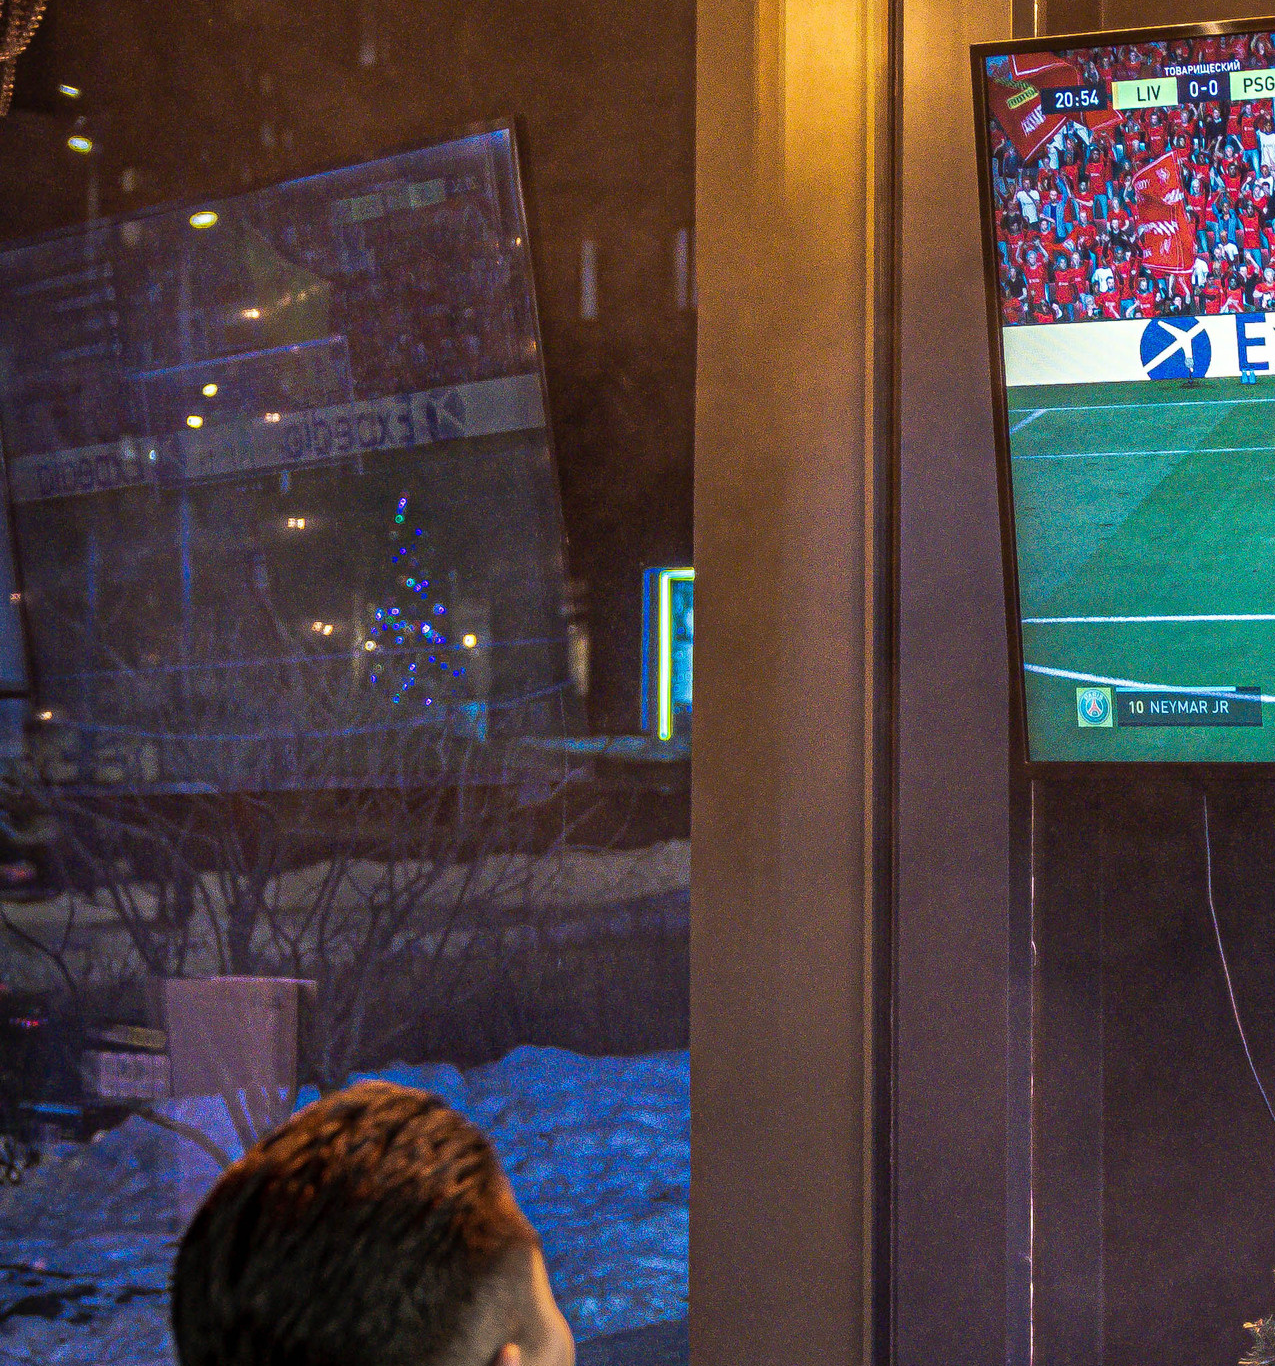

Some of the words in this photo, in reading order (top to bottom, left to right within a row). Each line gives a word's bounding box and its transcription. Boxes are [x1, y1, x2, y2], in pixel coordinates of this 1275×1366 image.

[1164, 59, 1241, 76] ТОВАРИЩЕСКИЙ
[1137, 85, 1161, 102] LIV
[1189, 80, 1218, 98] 0-0
[1243, 76, 1275, 94] PSG
[1055, 89, 1099, 109] 20:54
[1129, 700, 1144, 714] 10
[1150, 700, 1208, 714] NEYMAR
[1212, 700, 1229, 714] JR
